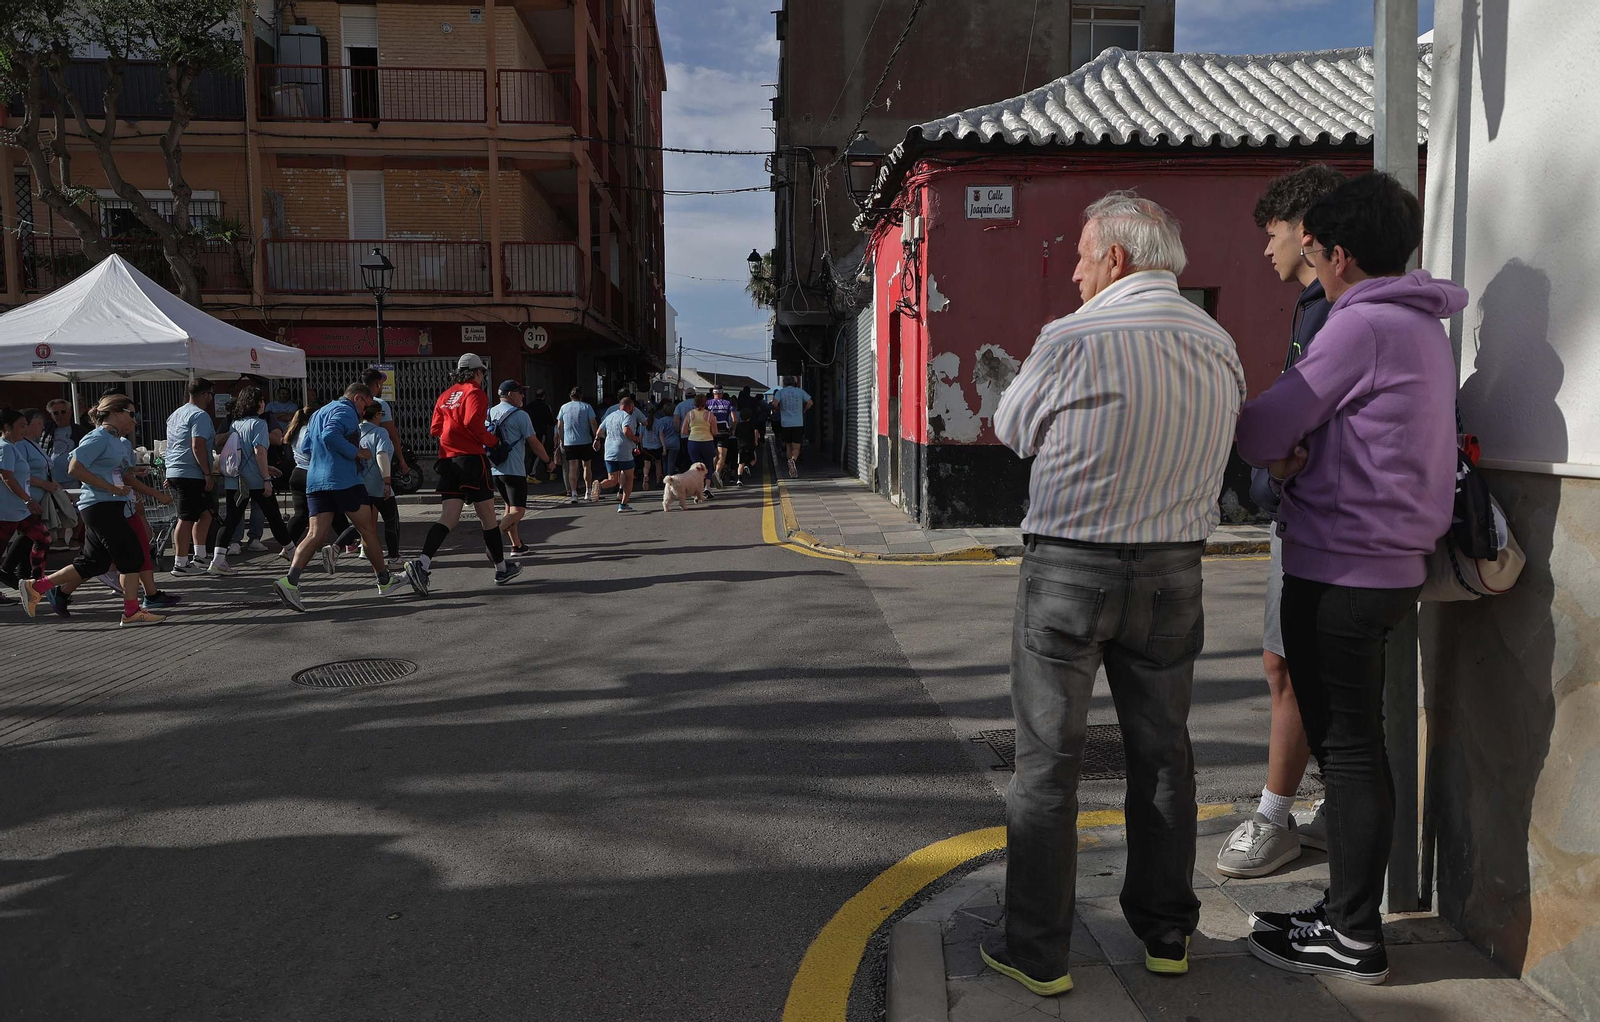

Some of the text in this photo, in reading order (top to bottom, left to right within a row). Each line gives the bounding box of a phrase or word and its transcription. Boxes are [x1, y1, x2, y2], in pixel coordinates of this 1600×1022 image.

[987, 190, 1003, 200] Calle
[970, 203, 1010, 217] Joaquín Costa
